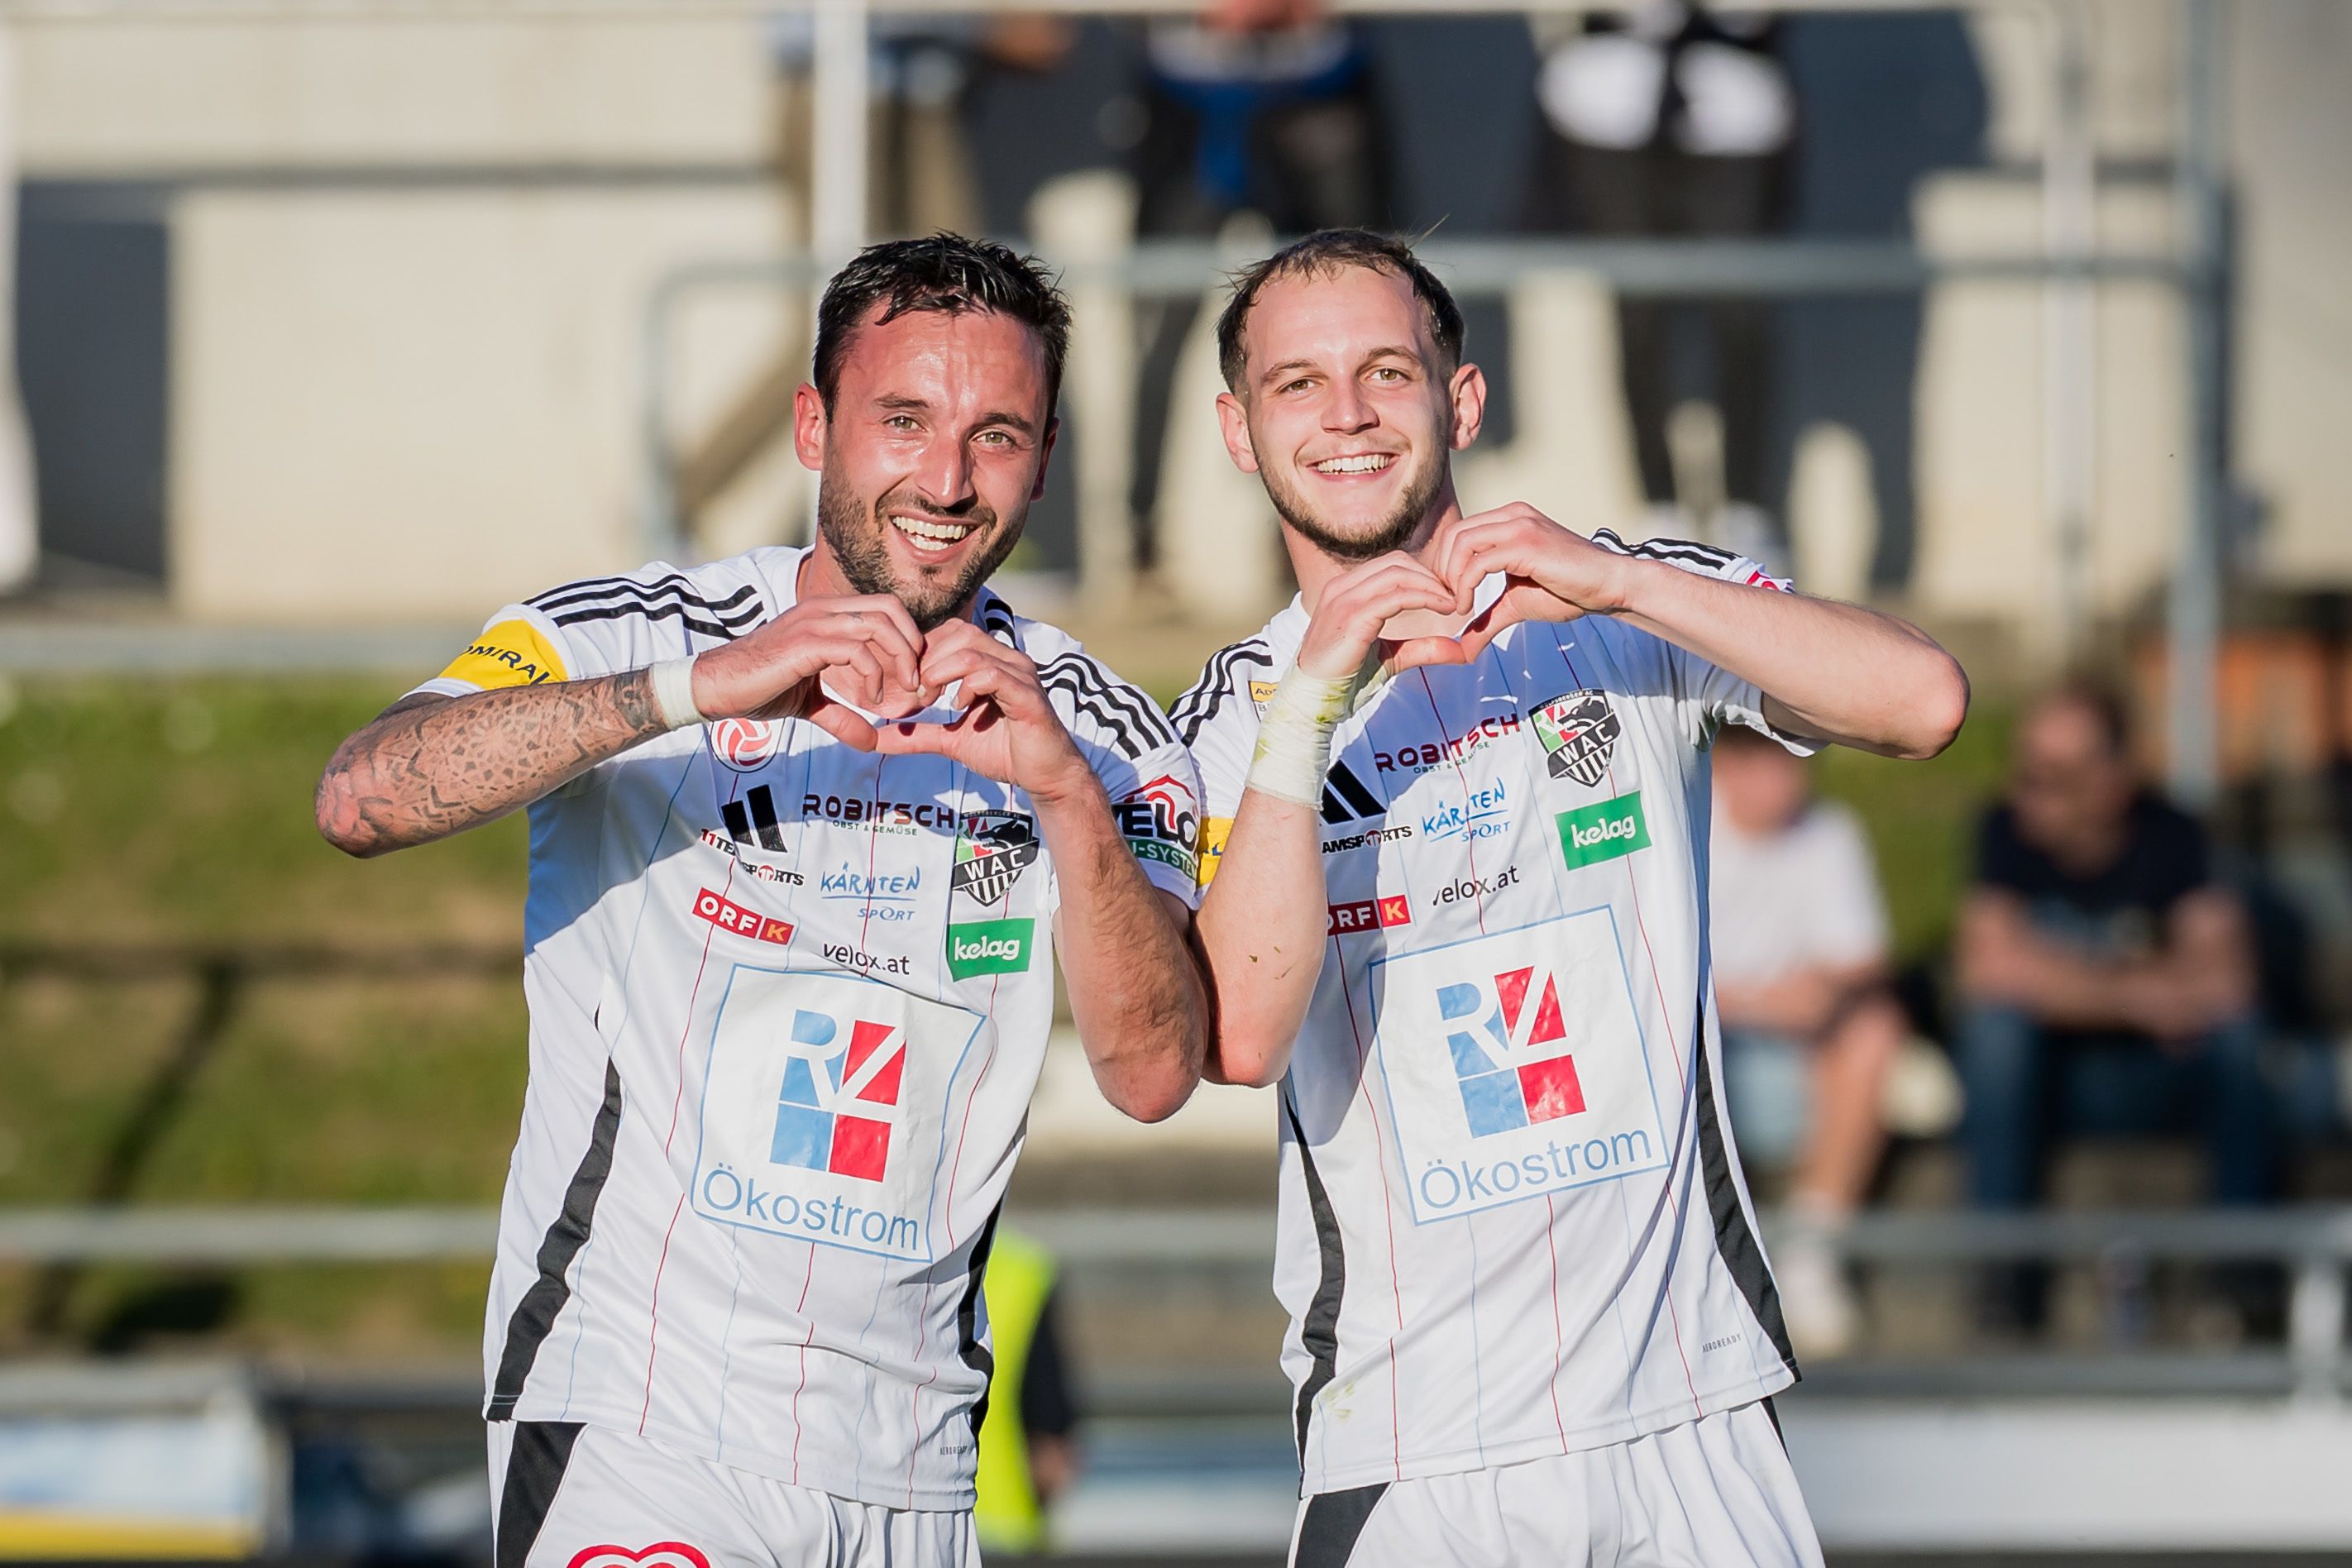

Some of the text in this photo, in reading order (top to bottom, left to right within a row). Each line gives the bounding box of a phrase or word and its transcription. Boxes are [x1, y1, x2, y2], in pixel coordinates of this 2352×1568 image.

[1374, 713, 1521, 773] ROBITSCH
[1556, 723, 1613, 766] WAC
[802, 794, 954, 829] ROBITSCH
[833, 820, 859, 831] OBST
[872, 826, 918, 836] GEMÜSE
[1461, 821, 1511, 842] SPORT
[1571, 814, 1637, 849] kelag
[820, 861, 920, 895] KÄRNTEN
[963, 849, 1025, 881] WAC
[700, 896, 789, 942] ORF K
[857, 906, 915, 921] SPORT
[1384, 900, 1406, 921] K
[824, 943, 911, 976] velox.at
[954, 935, 1021, 961] kelag
[1420, 1129, 1652, 1210] Ökostrom
[703, 1162, 919, 1251] Ökostrom
